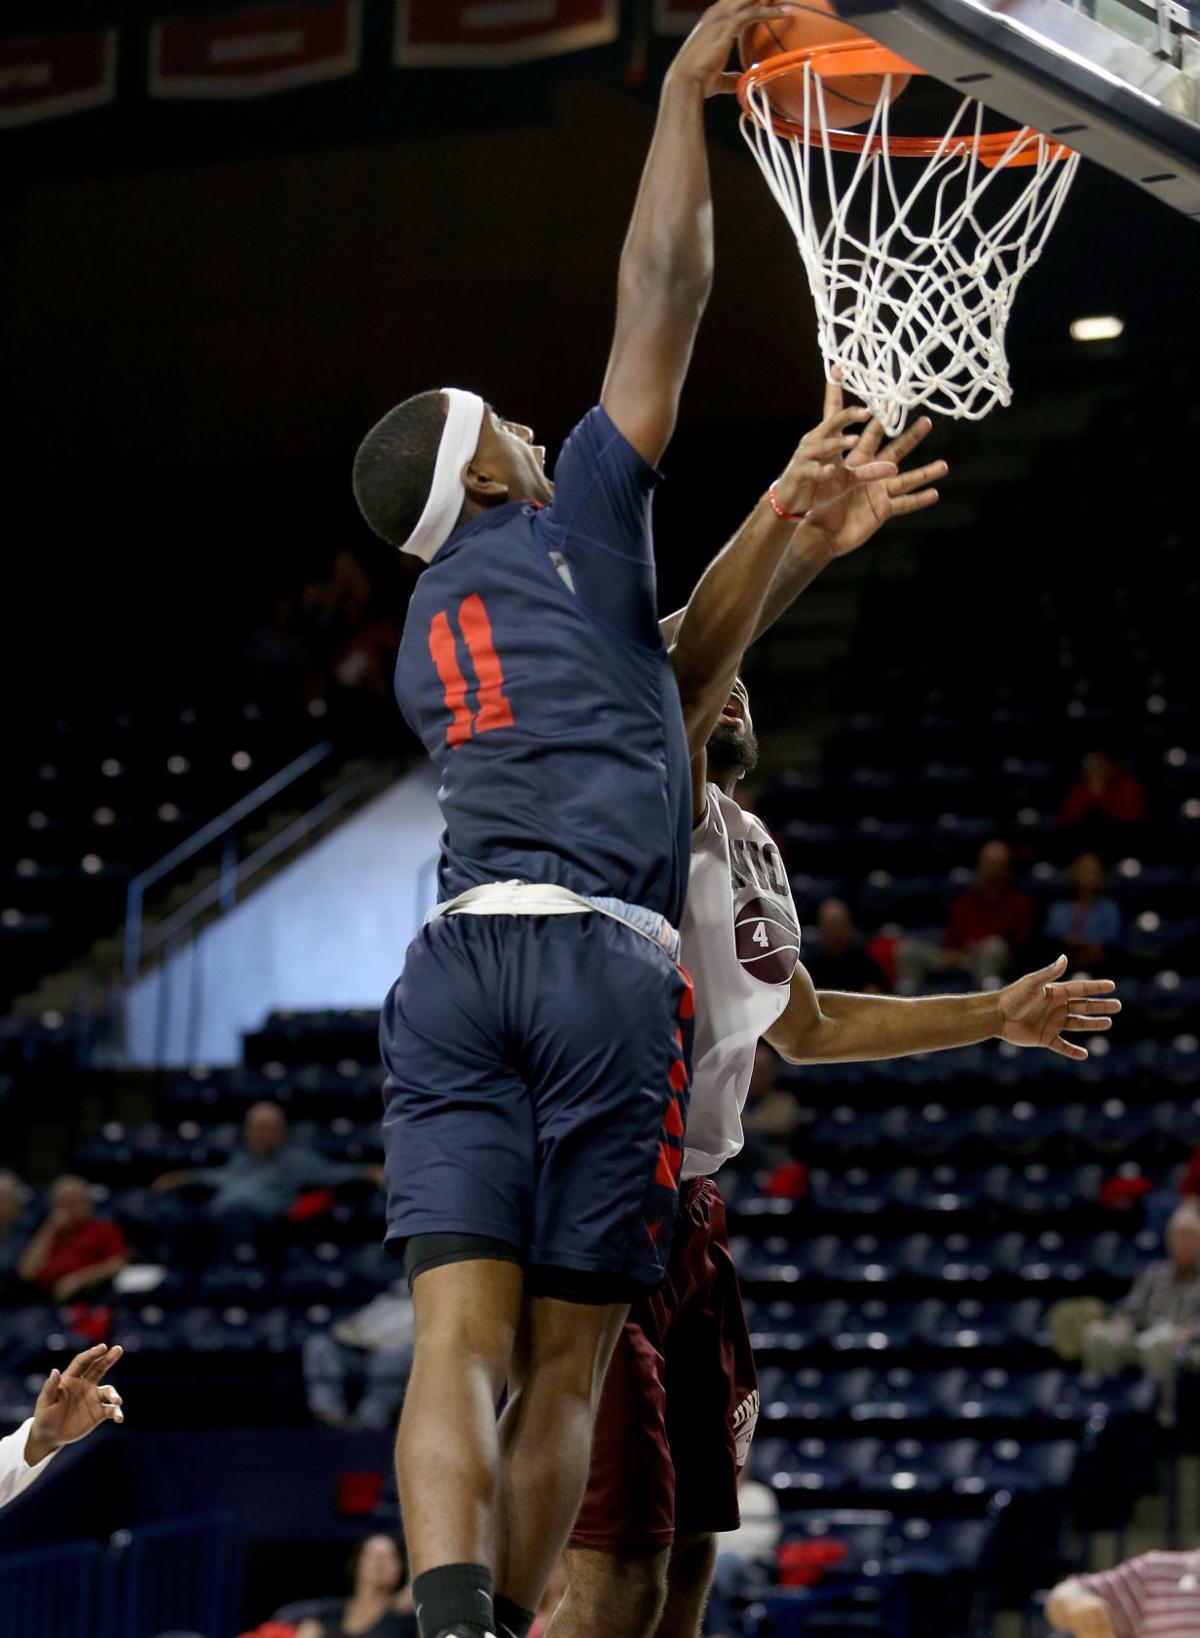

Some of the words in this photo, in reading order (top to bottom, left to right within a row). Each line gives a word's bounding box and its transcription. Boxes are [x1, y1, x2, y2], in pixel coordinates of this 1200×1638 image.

[428, 592, 515, 750] 11
[731, 839, 789, 896] NIO
[752, 921, 769, 947] 4
[732, 1389, 759, 1428] UNI
